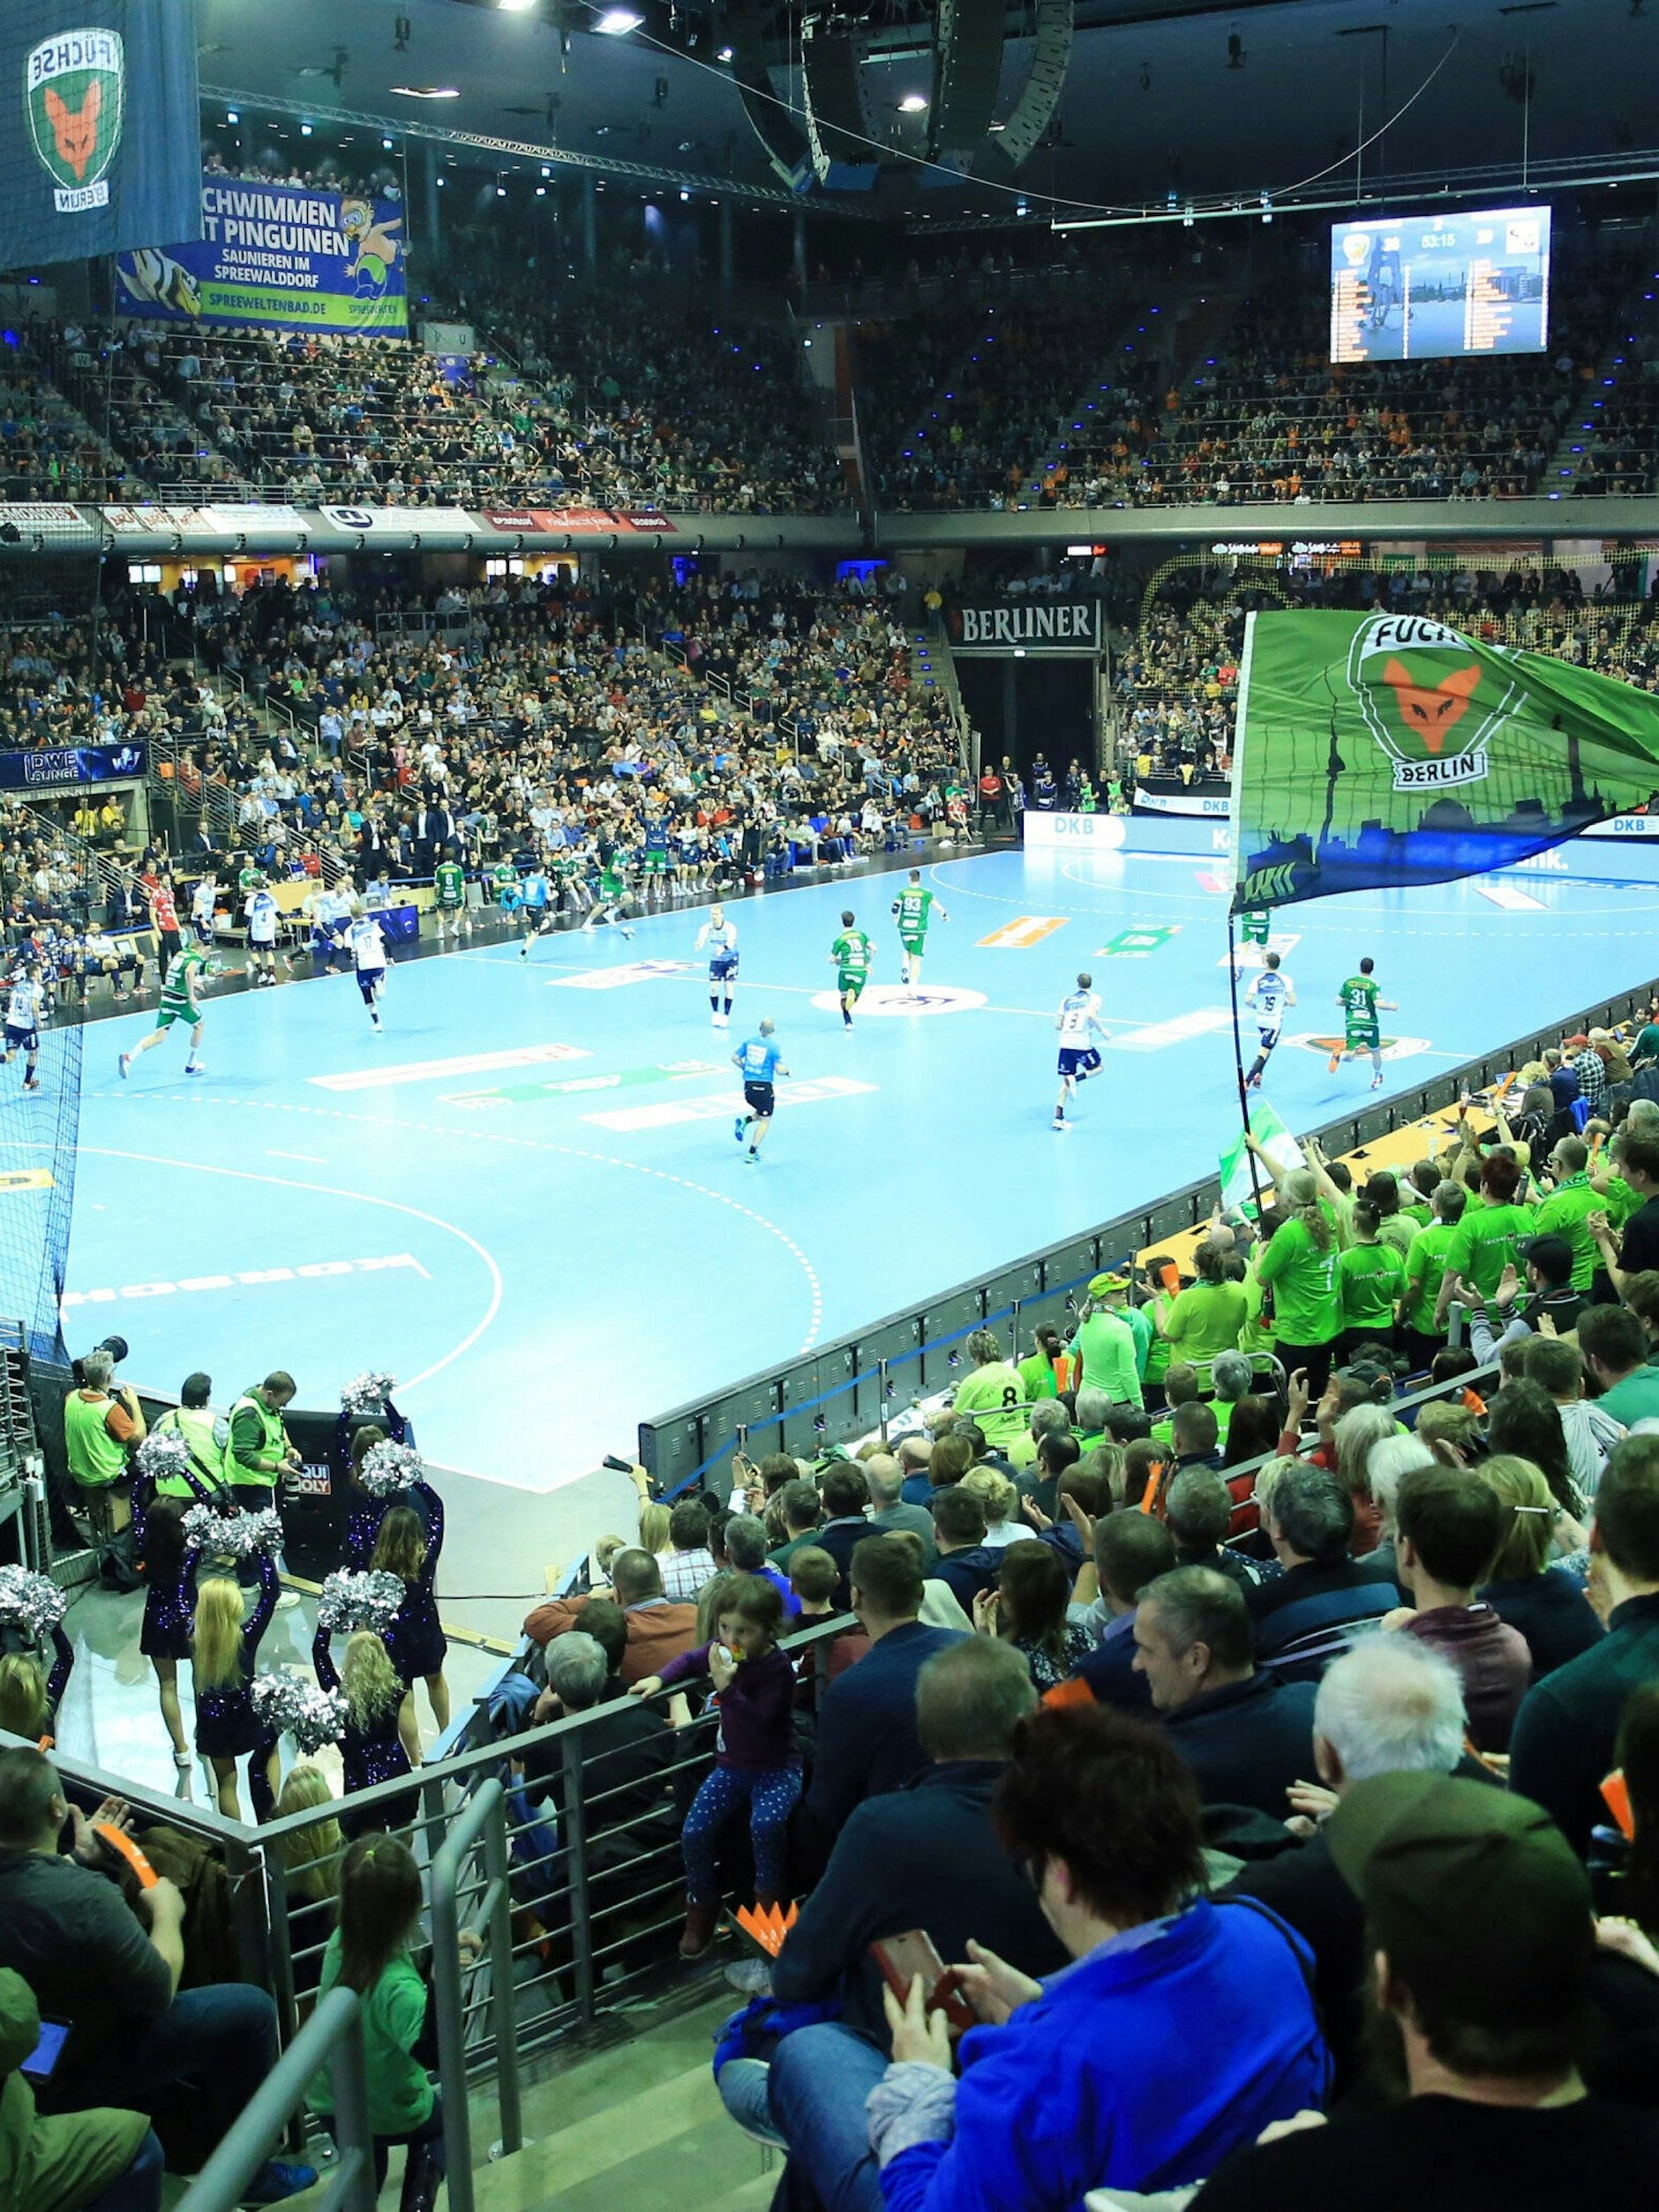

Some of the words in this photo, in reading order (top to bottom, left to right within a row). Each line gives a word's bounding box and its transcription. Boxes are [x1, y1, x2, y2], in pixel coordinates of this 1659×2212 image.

[223, 218, 350, 258] PINGUINEN
[221, 248, 292, 270] SAUNIEREN
[294, 256, 311, 272] IM
[214, 264, 319, 289] SPREEWALDDORF
[209, 292, 327, 315] SPREEWELTENBAD.DE
[962, 605, 1092, 644] BERLINER
[1401, 754, 1475, 782] BERLIN
[1203, 800, 1229, 813] DKB
[1055, 817, 1094, 835] DKB
[1614, 820, 1645, 832] DKB
[904, 896, 921, 912] 93
[1265, 996, 1276, 1011] 19
[1350, 988, 1367, 1006] 31
[1002, 1386, 1017, 1413] 8
